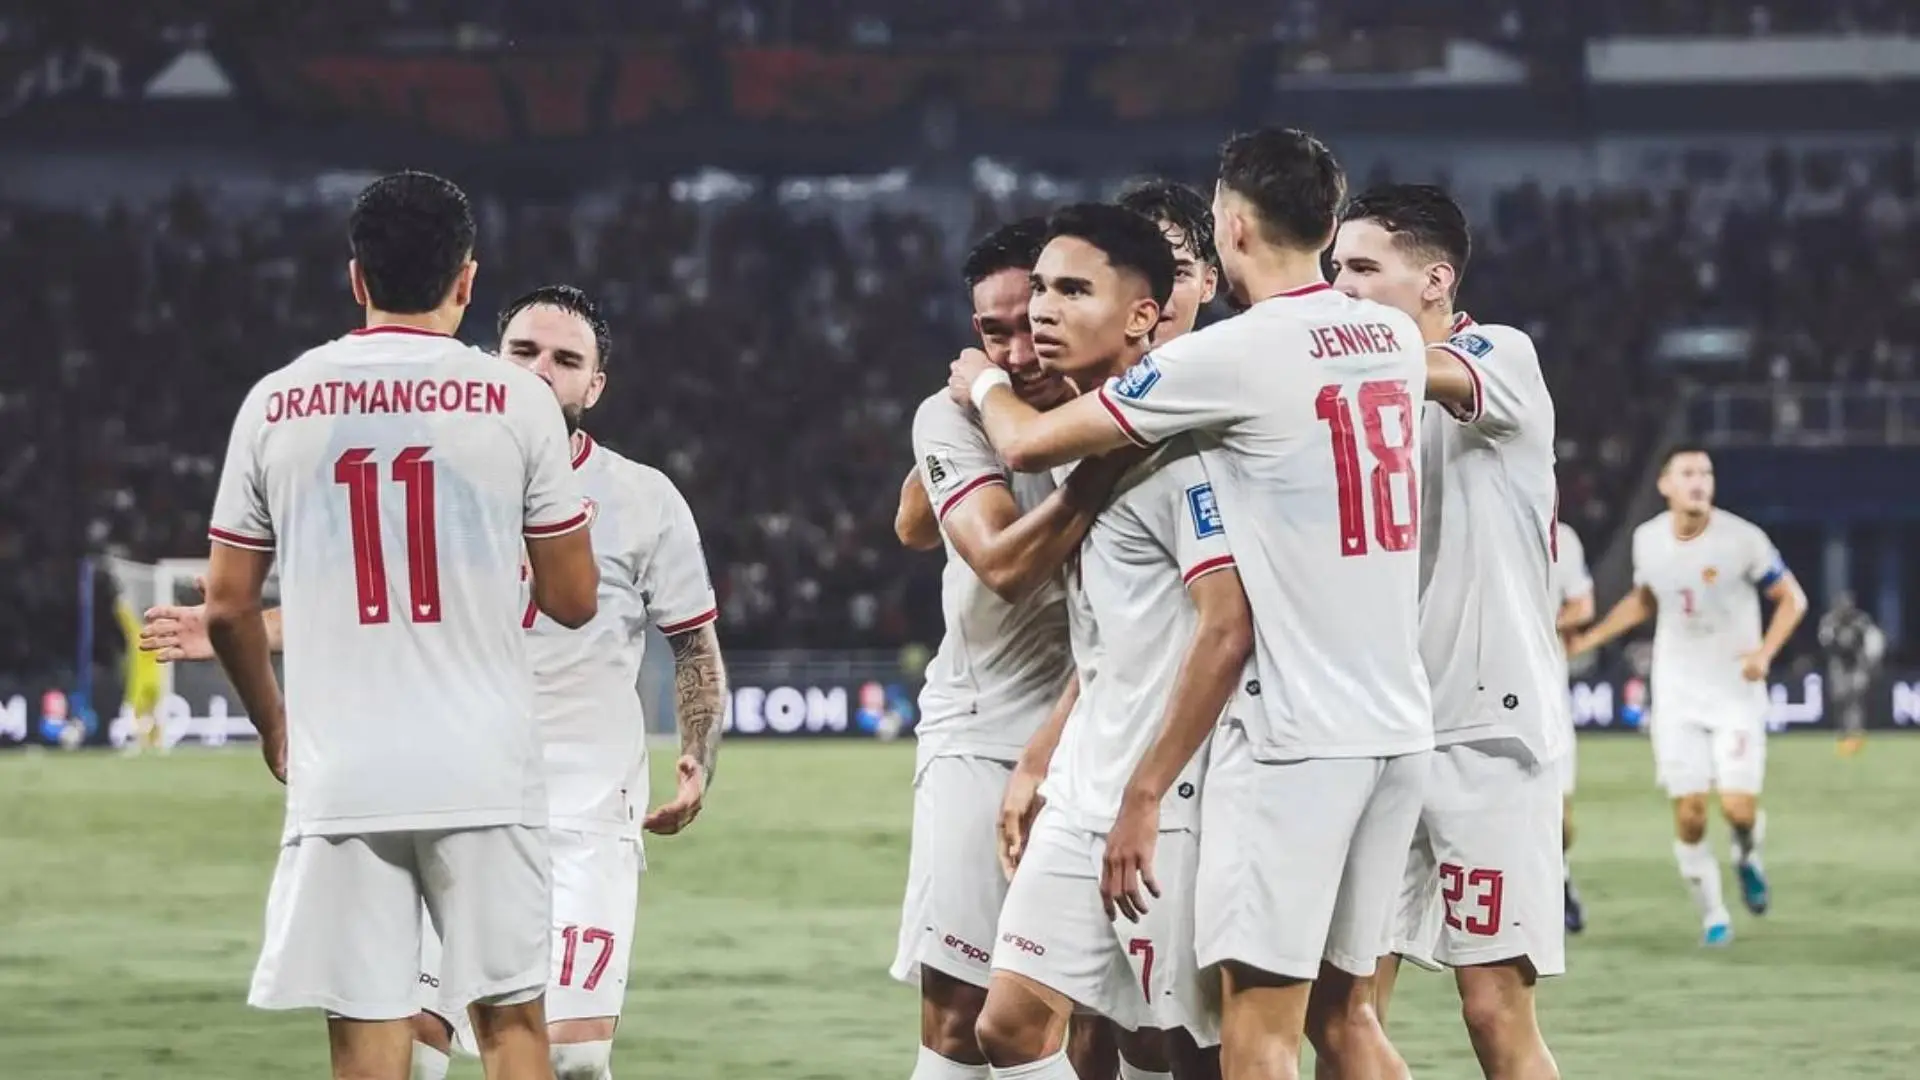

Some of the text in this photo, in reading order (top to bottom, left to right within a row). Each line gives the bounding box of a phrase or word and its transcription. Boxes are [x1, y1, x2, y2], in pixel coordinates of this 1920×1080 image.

[1309, 323, 1401, 359] JENNER
[265, 379, 506, 423] ORATMANGOEN
[1315, 379, 1418, 557] 18
[334, 446, 442, 625] 11
[1440, 862, 1503, 936] 23
[559, 925, 615, 991] 17
[943, 933, 990, 964] erspo
[1003, 930, 1045, 957] erspo
[1129, 938, 1155, 1005] 7
